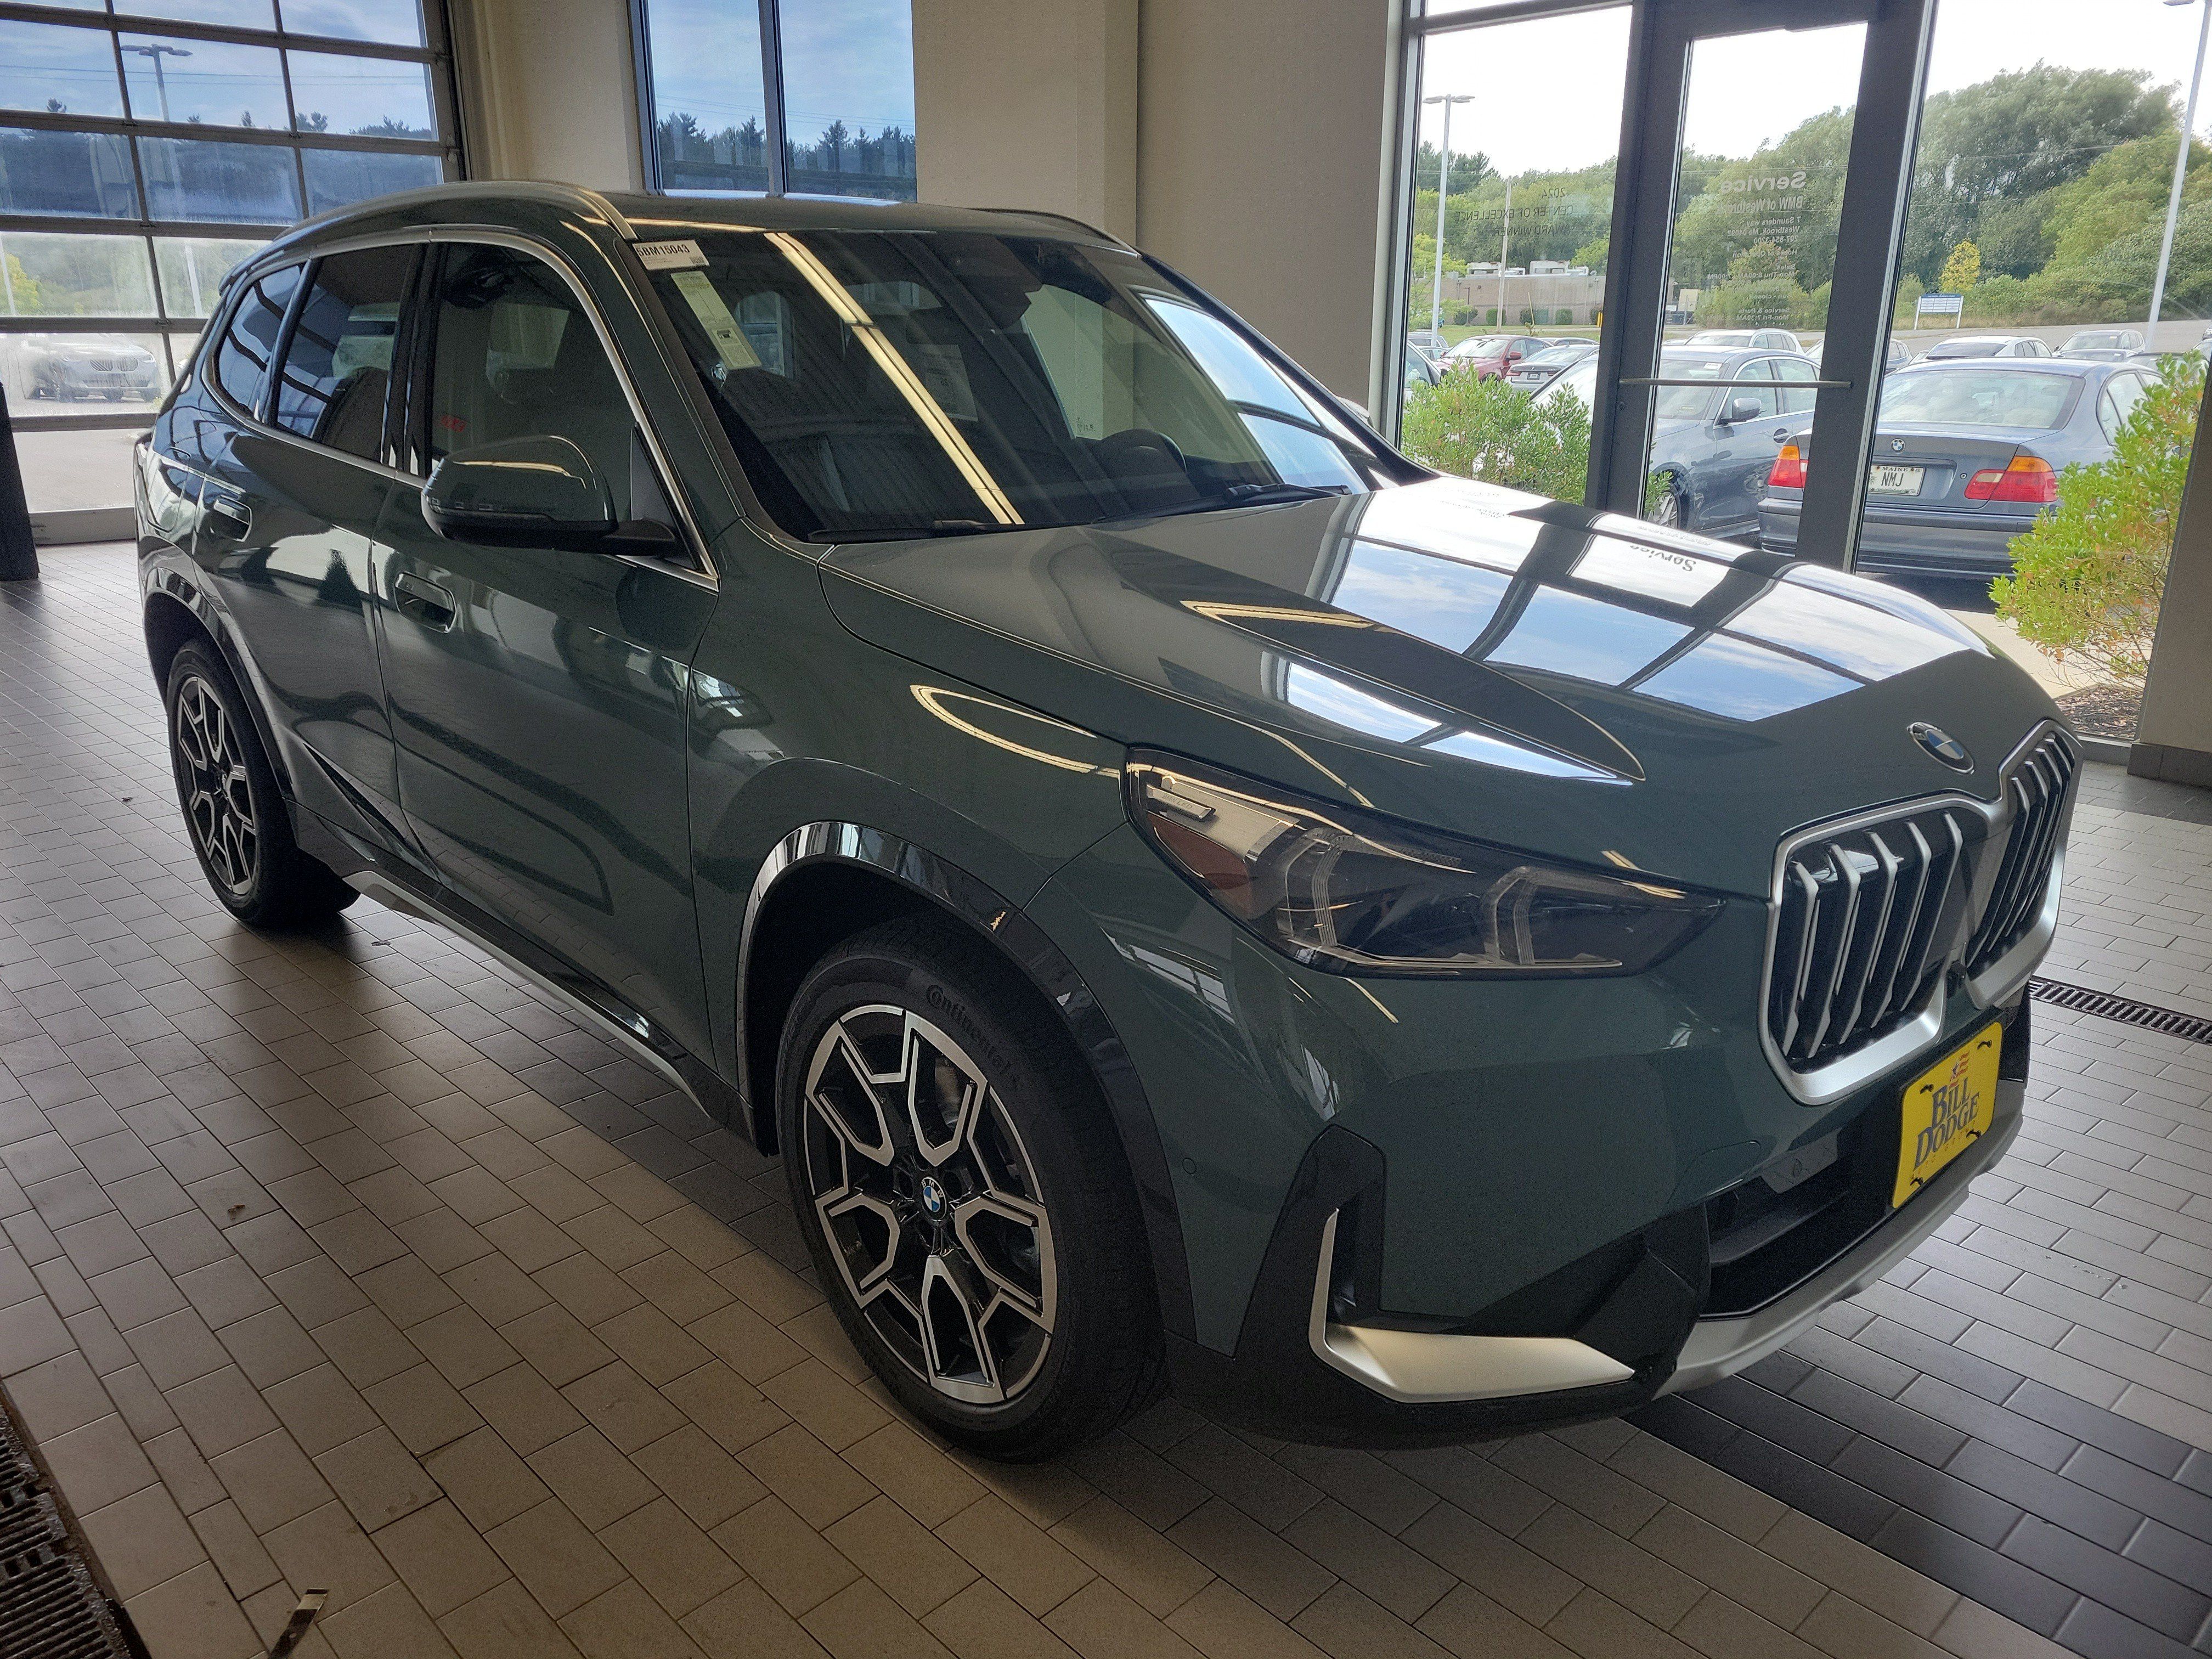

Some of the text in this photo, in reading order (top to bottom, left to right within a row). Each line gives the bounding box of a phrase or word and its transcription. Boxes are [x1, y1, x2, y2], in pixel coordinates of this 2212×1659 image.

[1881, 472, 1904, 487] NMJ
[1177, 801, 1193, 809] LED
[1932, 1076, 1972, 1127] BILL
[1914, 1092, 1980, 1169] DODGE
[921, 1180, 944, 1198] BMW
